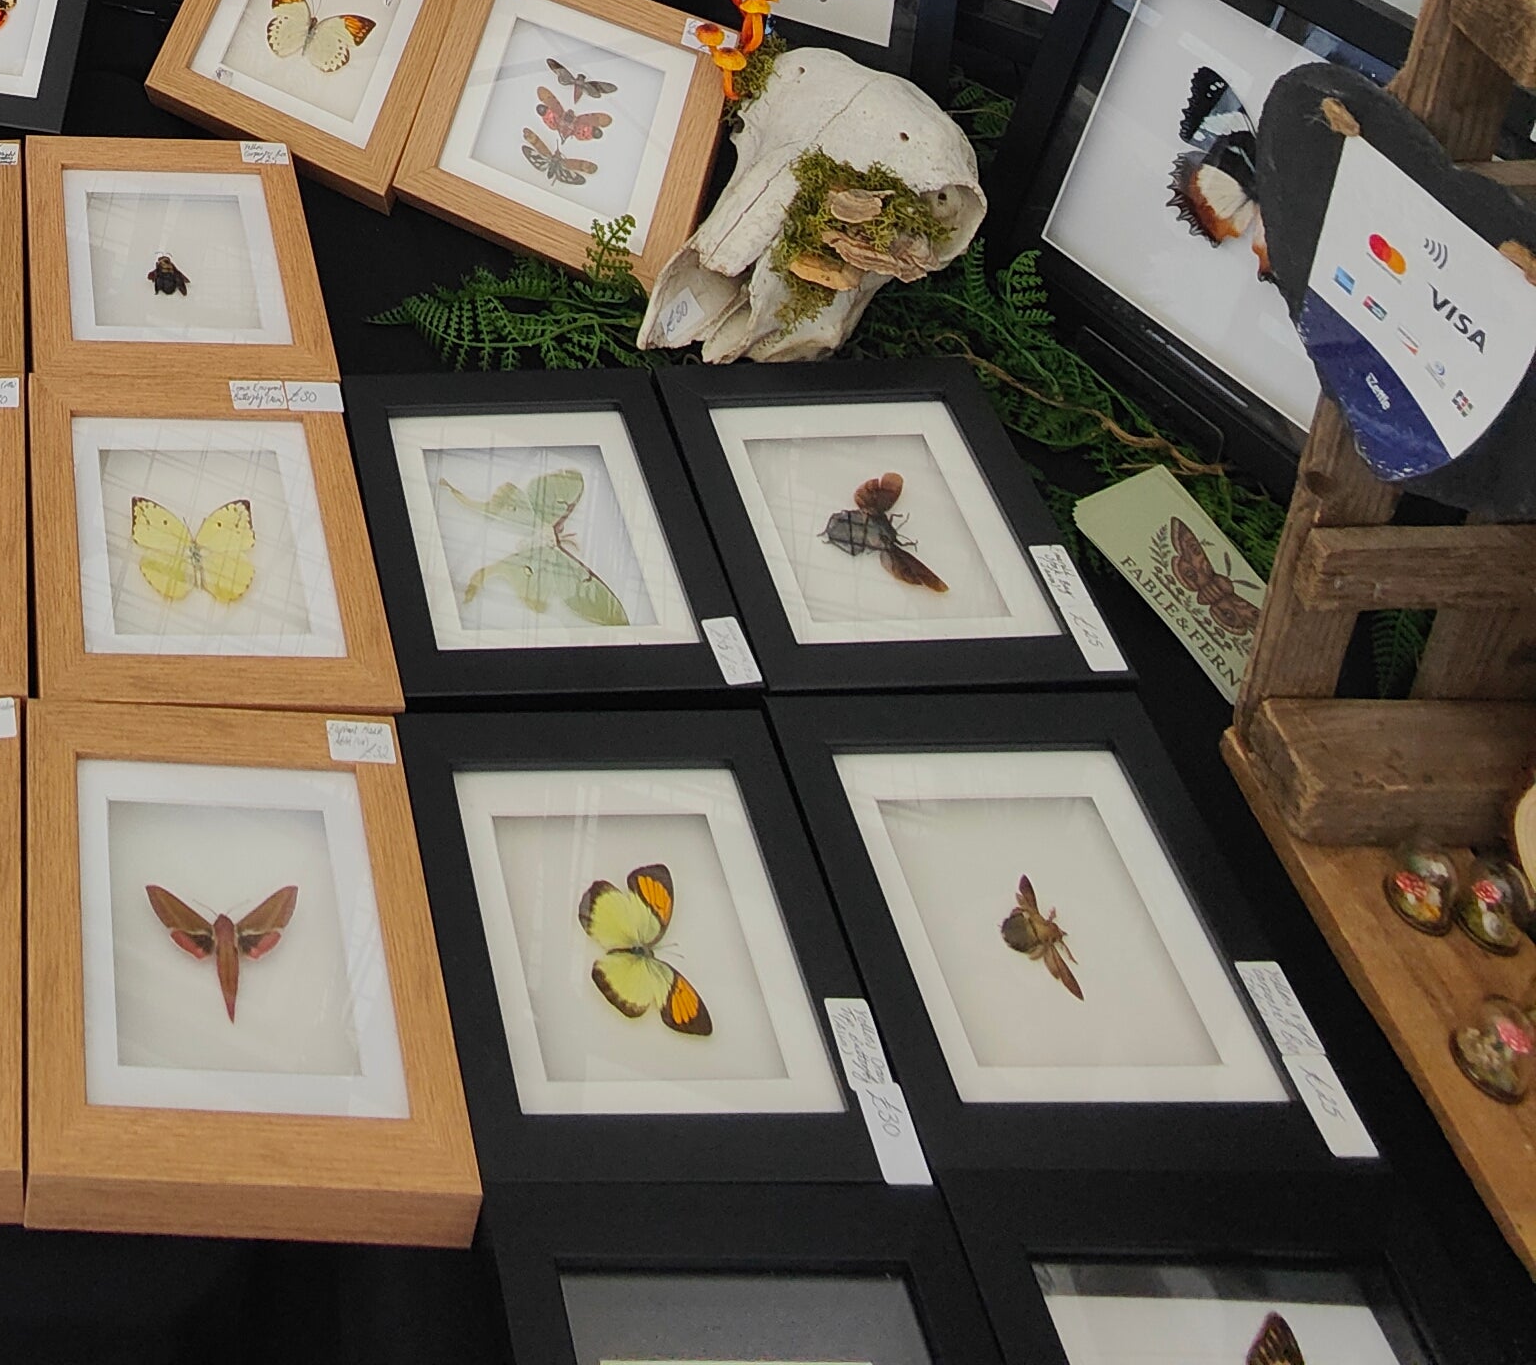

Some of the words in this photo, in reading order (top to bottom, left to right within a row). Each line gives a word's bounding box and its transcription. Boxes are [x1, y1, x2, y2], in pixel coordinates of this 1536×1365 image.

[1427, 281, 1486, 355] VISA
[287, 387, 318, 404] £30
[1068, 604, 1106, 654] £25
[1120, 555, 1178, 619] FABLE
[1176, 616, 1191, 630] &
[1188, 630, 1242, 688] FERN
[865, 1080, 910, 1142] £30
[1296, 1055, 1351, 1129] £25
